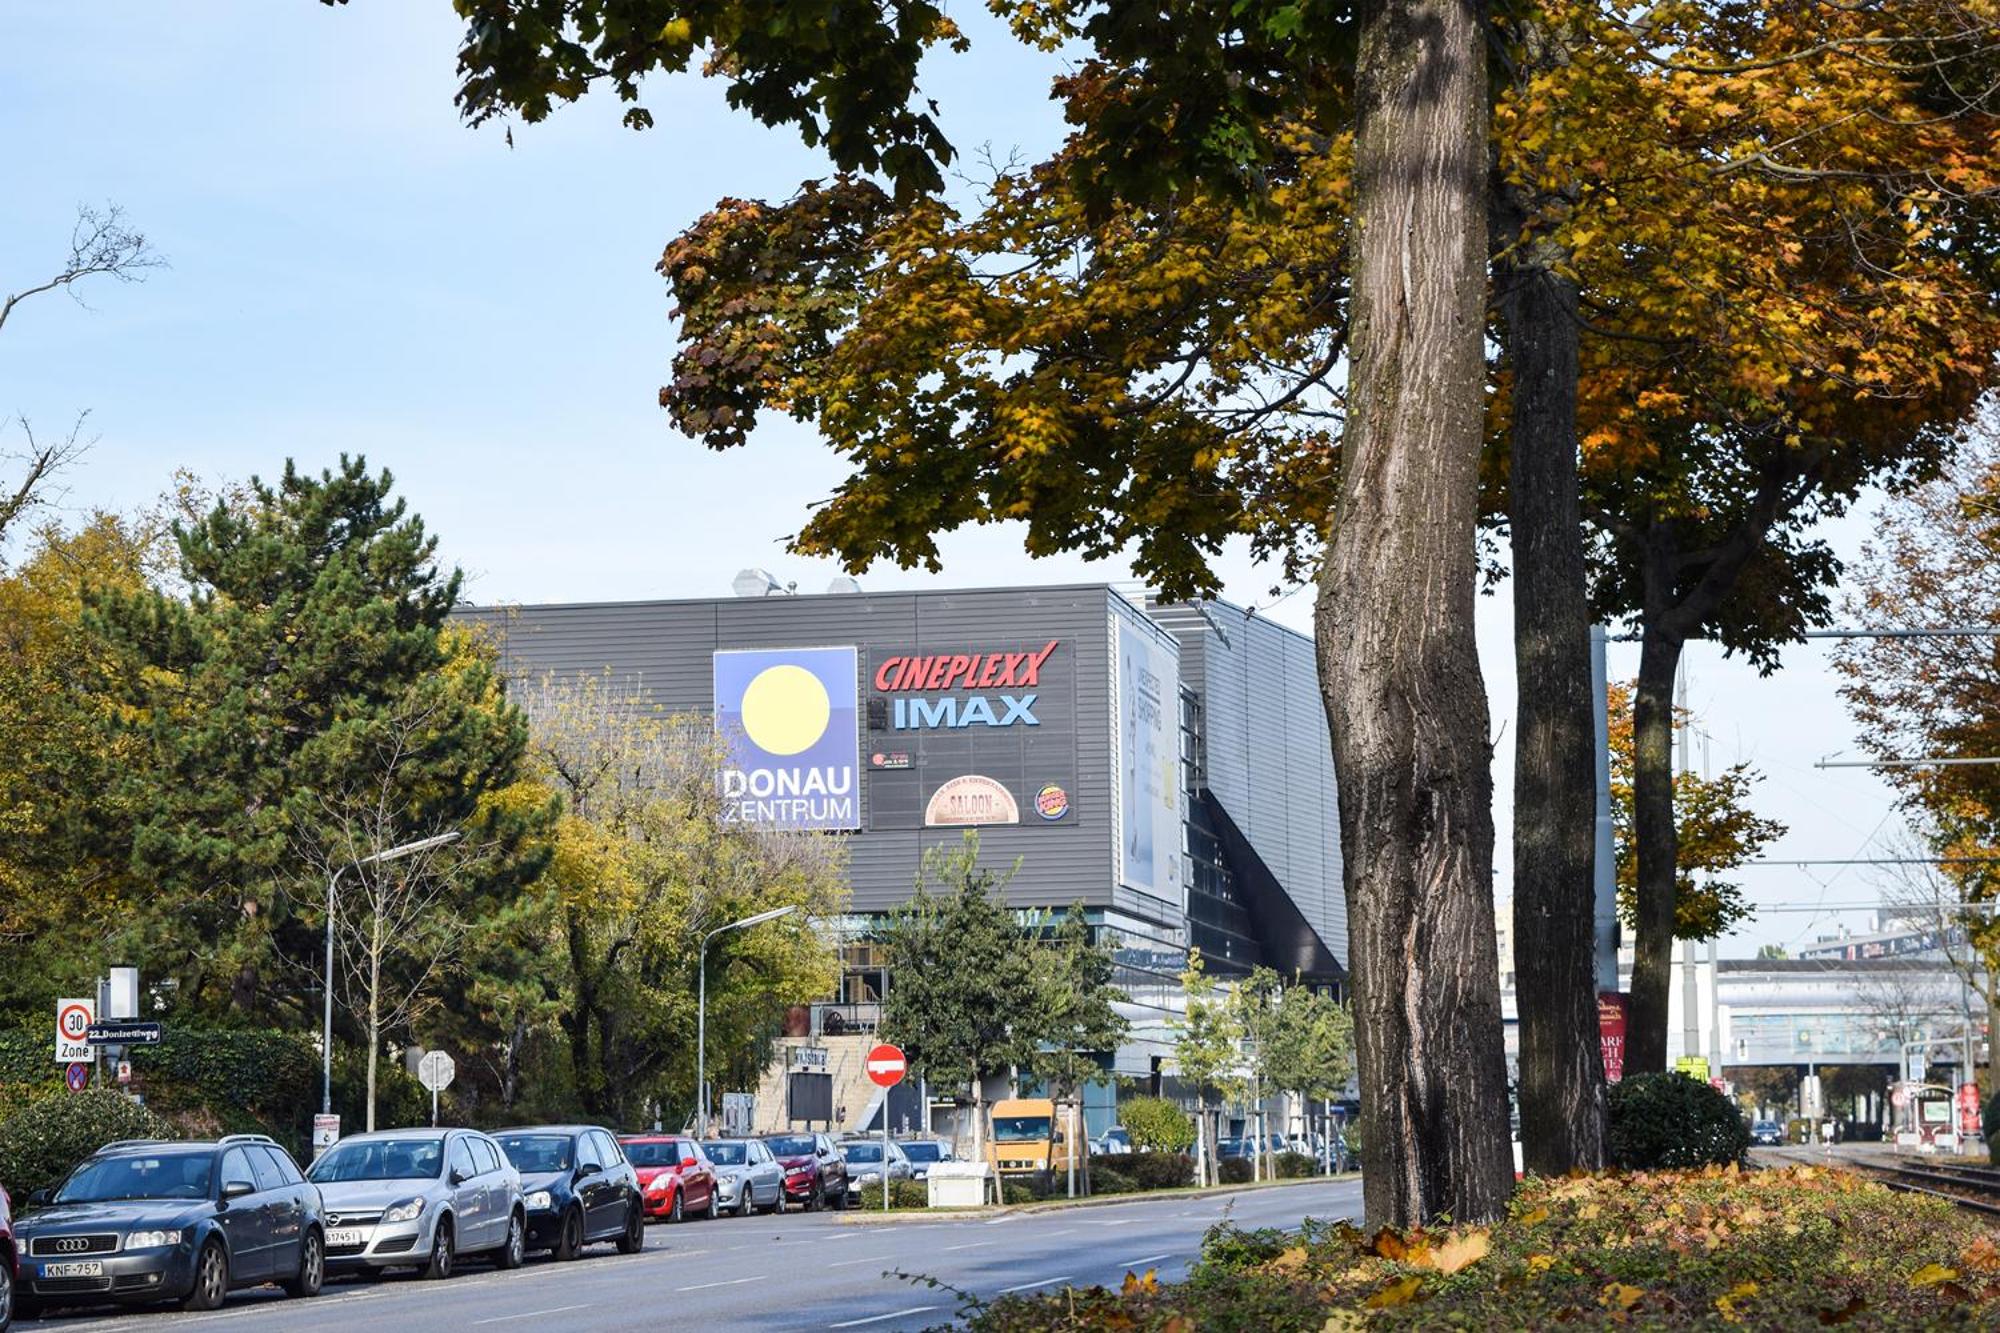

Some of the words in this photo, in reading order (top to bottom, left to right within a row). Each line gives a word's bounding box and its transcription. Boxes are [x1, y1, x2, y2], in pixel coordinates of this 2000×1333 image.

[875, 640, 1059, 692] CINEPLEXX
[894, 694, 1040, 729] IMAX
[723, 766, 851, 797] DONAU
[721, 797, 852, 821] ZENTRUM
[950, 794, 993, 816] SALOON
[69, 1014, 84, 1031] 30
[62, 1043, 89, 1058] Zone
[47, 1263, 99, 1277] KNF-757
